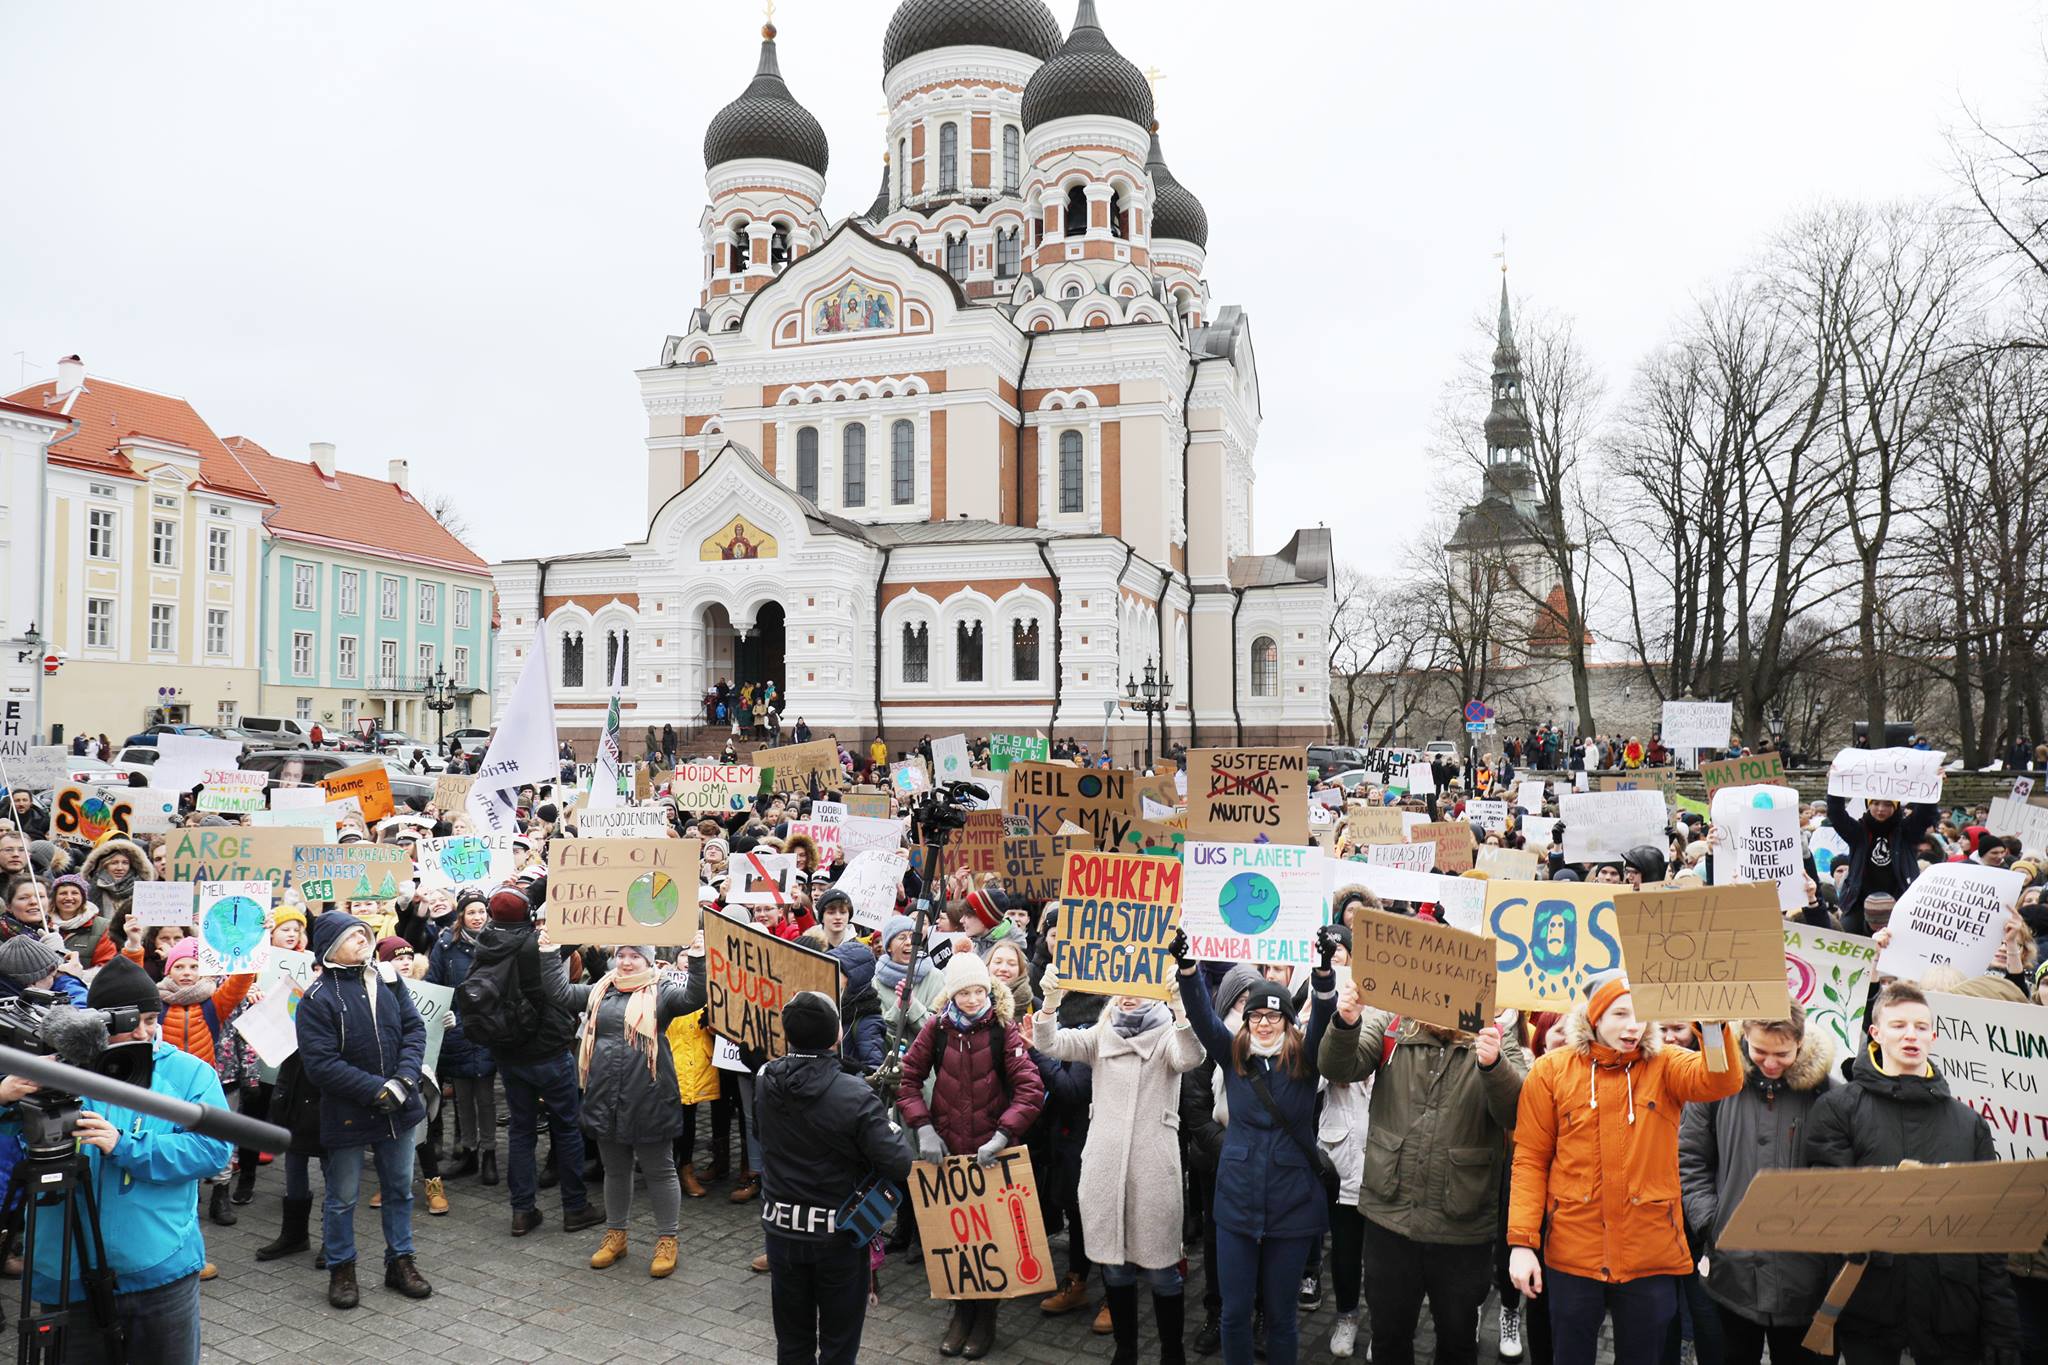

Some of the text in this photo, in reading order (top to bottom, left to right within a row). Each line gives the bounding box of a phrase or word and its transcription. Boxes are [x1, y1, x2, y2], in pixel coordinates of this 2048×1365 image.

[675, 766, 753, 783] HOIDKEM
[1014, 769, 1070, 797] MEIL
[1705, 759, 1783, 785] MAA POLE
[676, 792, 725, 808] KODU!
[702, 784, 728, 794] OMA
[1209, 803, 1280, 826] MUUTUS
[174, 828, 254, 859] ÄRGE
[422, 833, 507, 852] MEIL EI OLE
[622, 828, 635, 836] OLE
[1750, 826, 1773, 838] KES
[295, 847, 345, 863] KUMBA
[425, 850, 485, 870] PLANEET
[560, 845, 668, 866] AEG ON
[1003, 840, 1046, 859] MEIL
[1194, 843, 1307, 867] ÜKS PLANEET
[1750, 854, 1779, 866] MEIE
[1007, 859, 1044, 876] OLE
[1067, 854, 1181, 903] ROHKEM
[202, 884, 227, 897] MEIL
[1951, 890, 2000, 913] ELUAJA
[561, 905, 627, 927] KORRAL
[1638, 896, 1757, 933] MEIL
[1909, 906, 1986, 937] JUHTU VEEL
[1915, 895, 1991, 924] JOOKSUL EI
[1192, 935, 1315, 963] KAMBA PEALE!
[1361, 920, 1488, 963] TERVE MAAILM
[1489, 897, 1621, 975] SOS
[1645, 931, 1758, 960] POLE
[233, 946, 241, 957] 6
[727, 934, 783, 984] MEIL
[1391, 981, 1451, 1009] ALAKS!
[1659, 983, 1760, 1012] MINNA
[709, 981, 788, 1058] PLANE
[1929, 1053, 2038, 1094] NNE, KUI
[762, 1201, 836, 1233] DELFI
[950, 1203, 993, 1243] ON
[932, 1242, 1008, 1294] TÄIS
